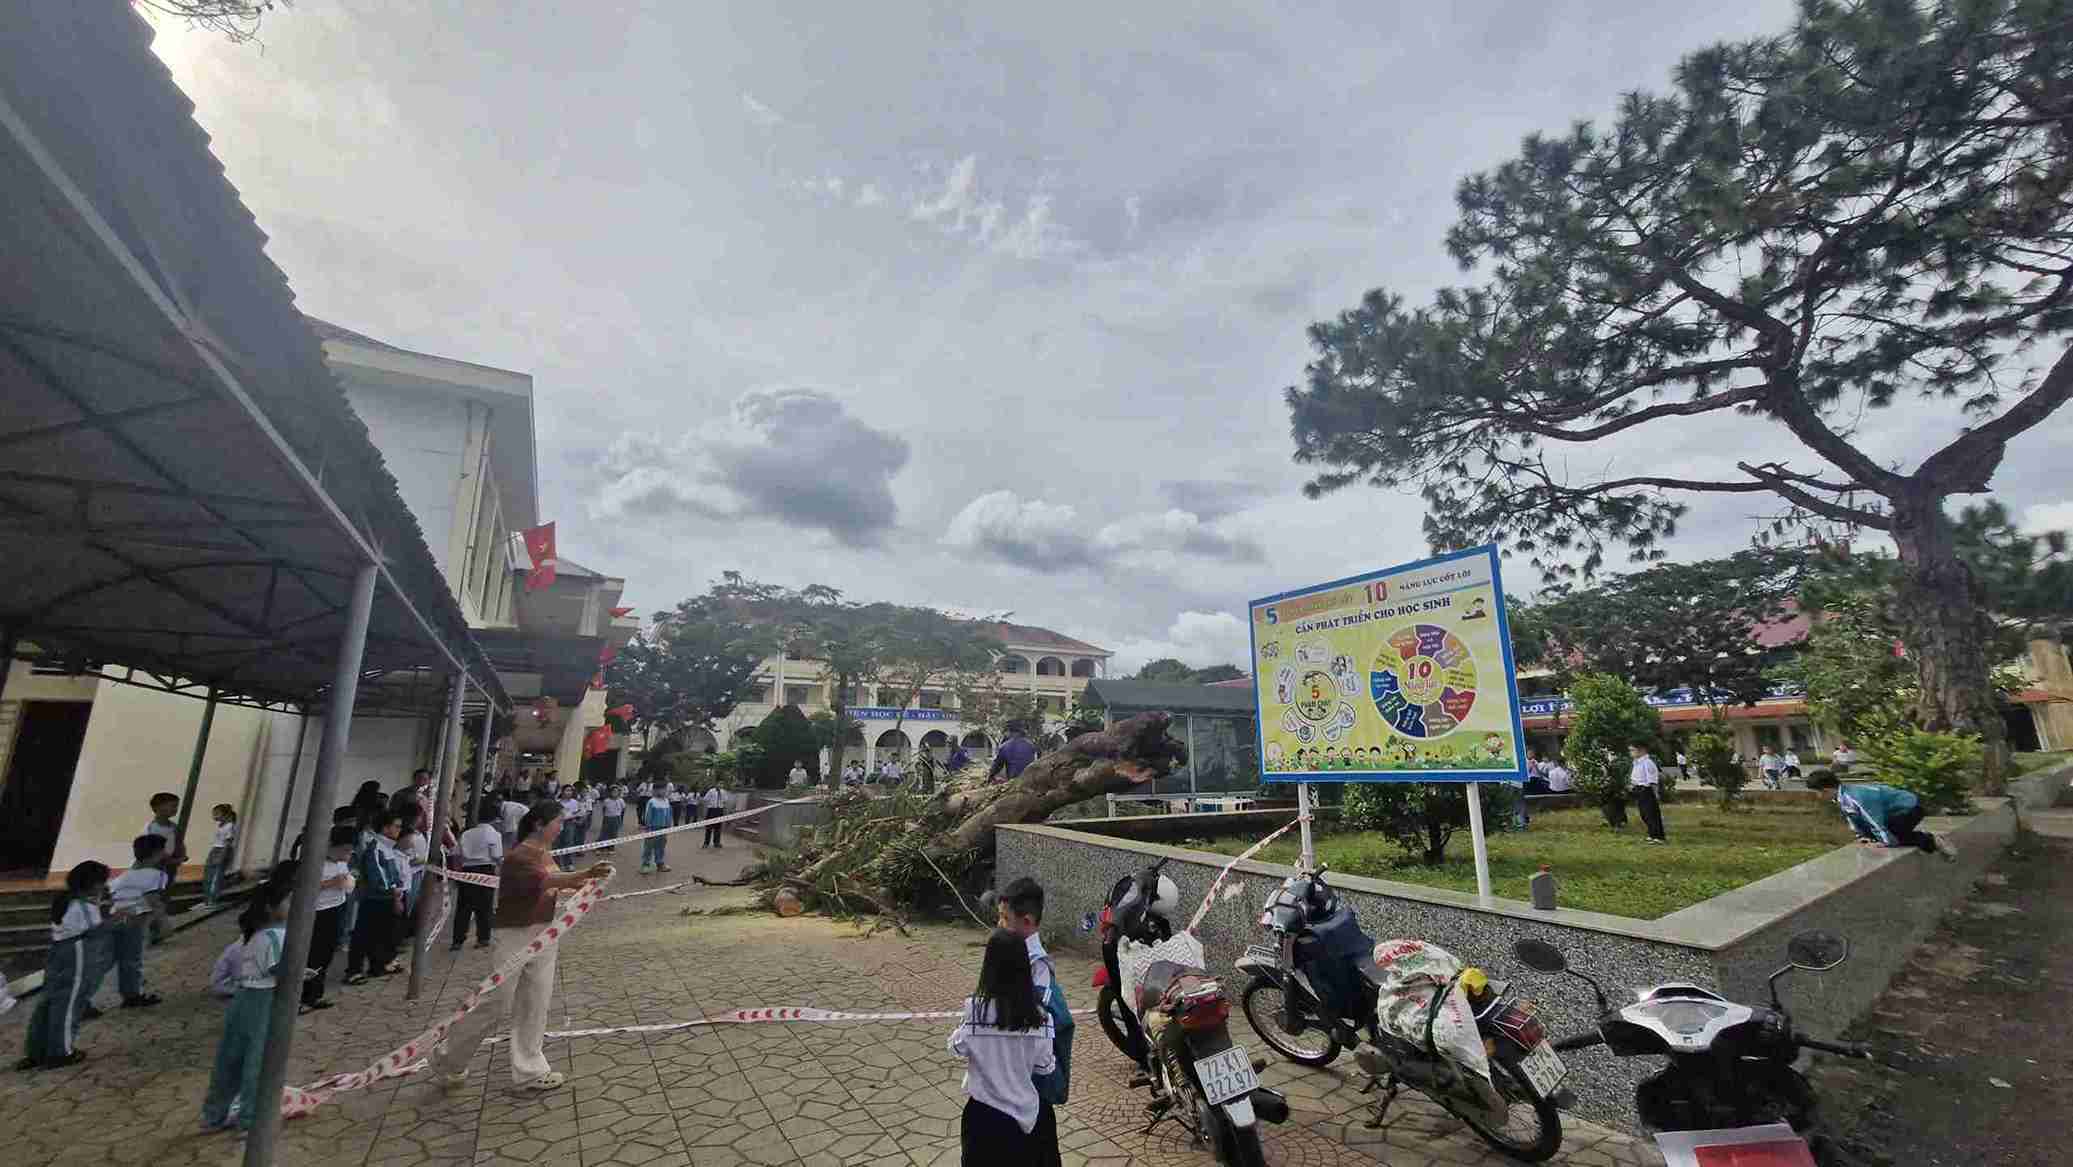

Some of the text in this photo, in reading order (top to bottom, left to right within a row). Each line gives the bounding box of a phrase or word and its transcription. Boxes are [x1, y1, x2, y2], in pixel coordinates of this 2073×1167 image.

[1266, 608, 1278, 624] 5
[1364, 581, 1388, 604] 10
[1374, 607, 1395, 619] CHO
[1398, 603, 1420, 616] HỌC
[1423, 598, 1450, 611] SINH
[1409, 661, 1432, 680] 10
[1312, 685, 1320, 699] 5
